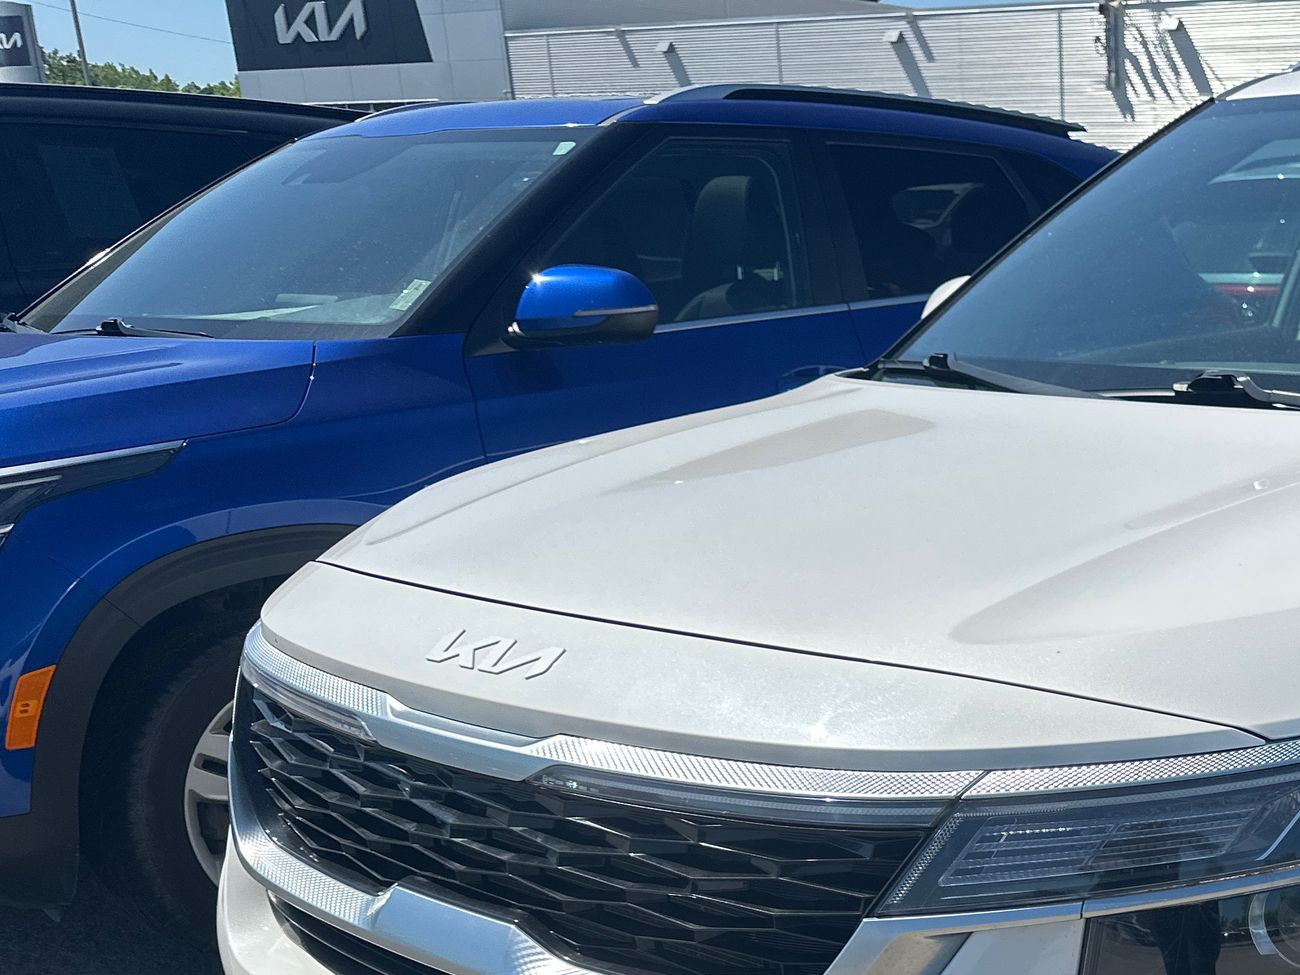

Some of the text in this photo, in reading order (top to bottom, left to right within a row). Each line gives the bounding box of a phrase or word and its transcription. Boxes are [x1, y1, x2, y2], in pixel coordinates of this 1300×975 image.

[0, 32, 23, 50] IA
[273, 0, 367, 44] KIA
[425, 628, 567, 681] KIA
